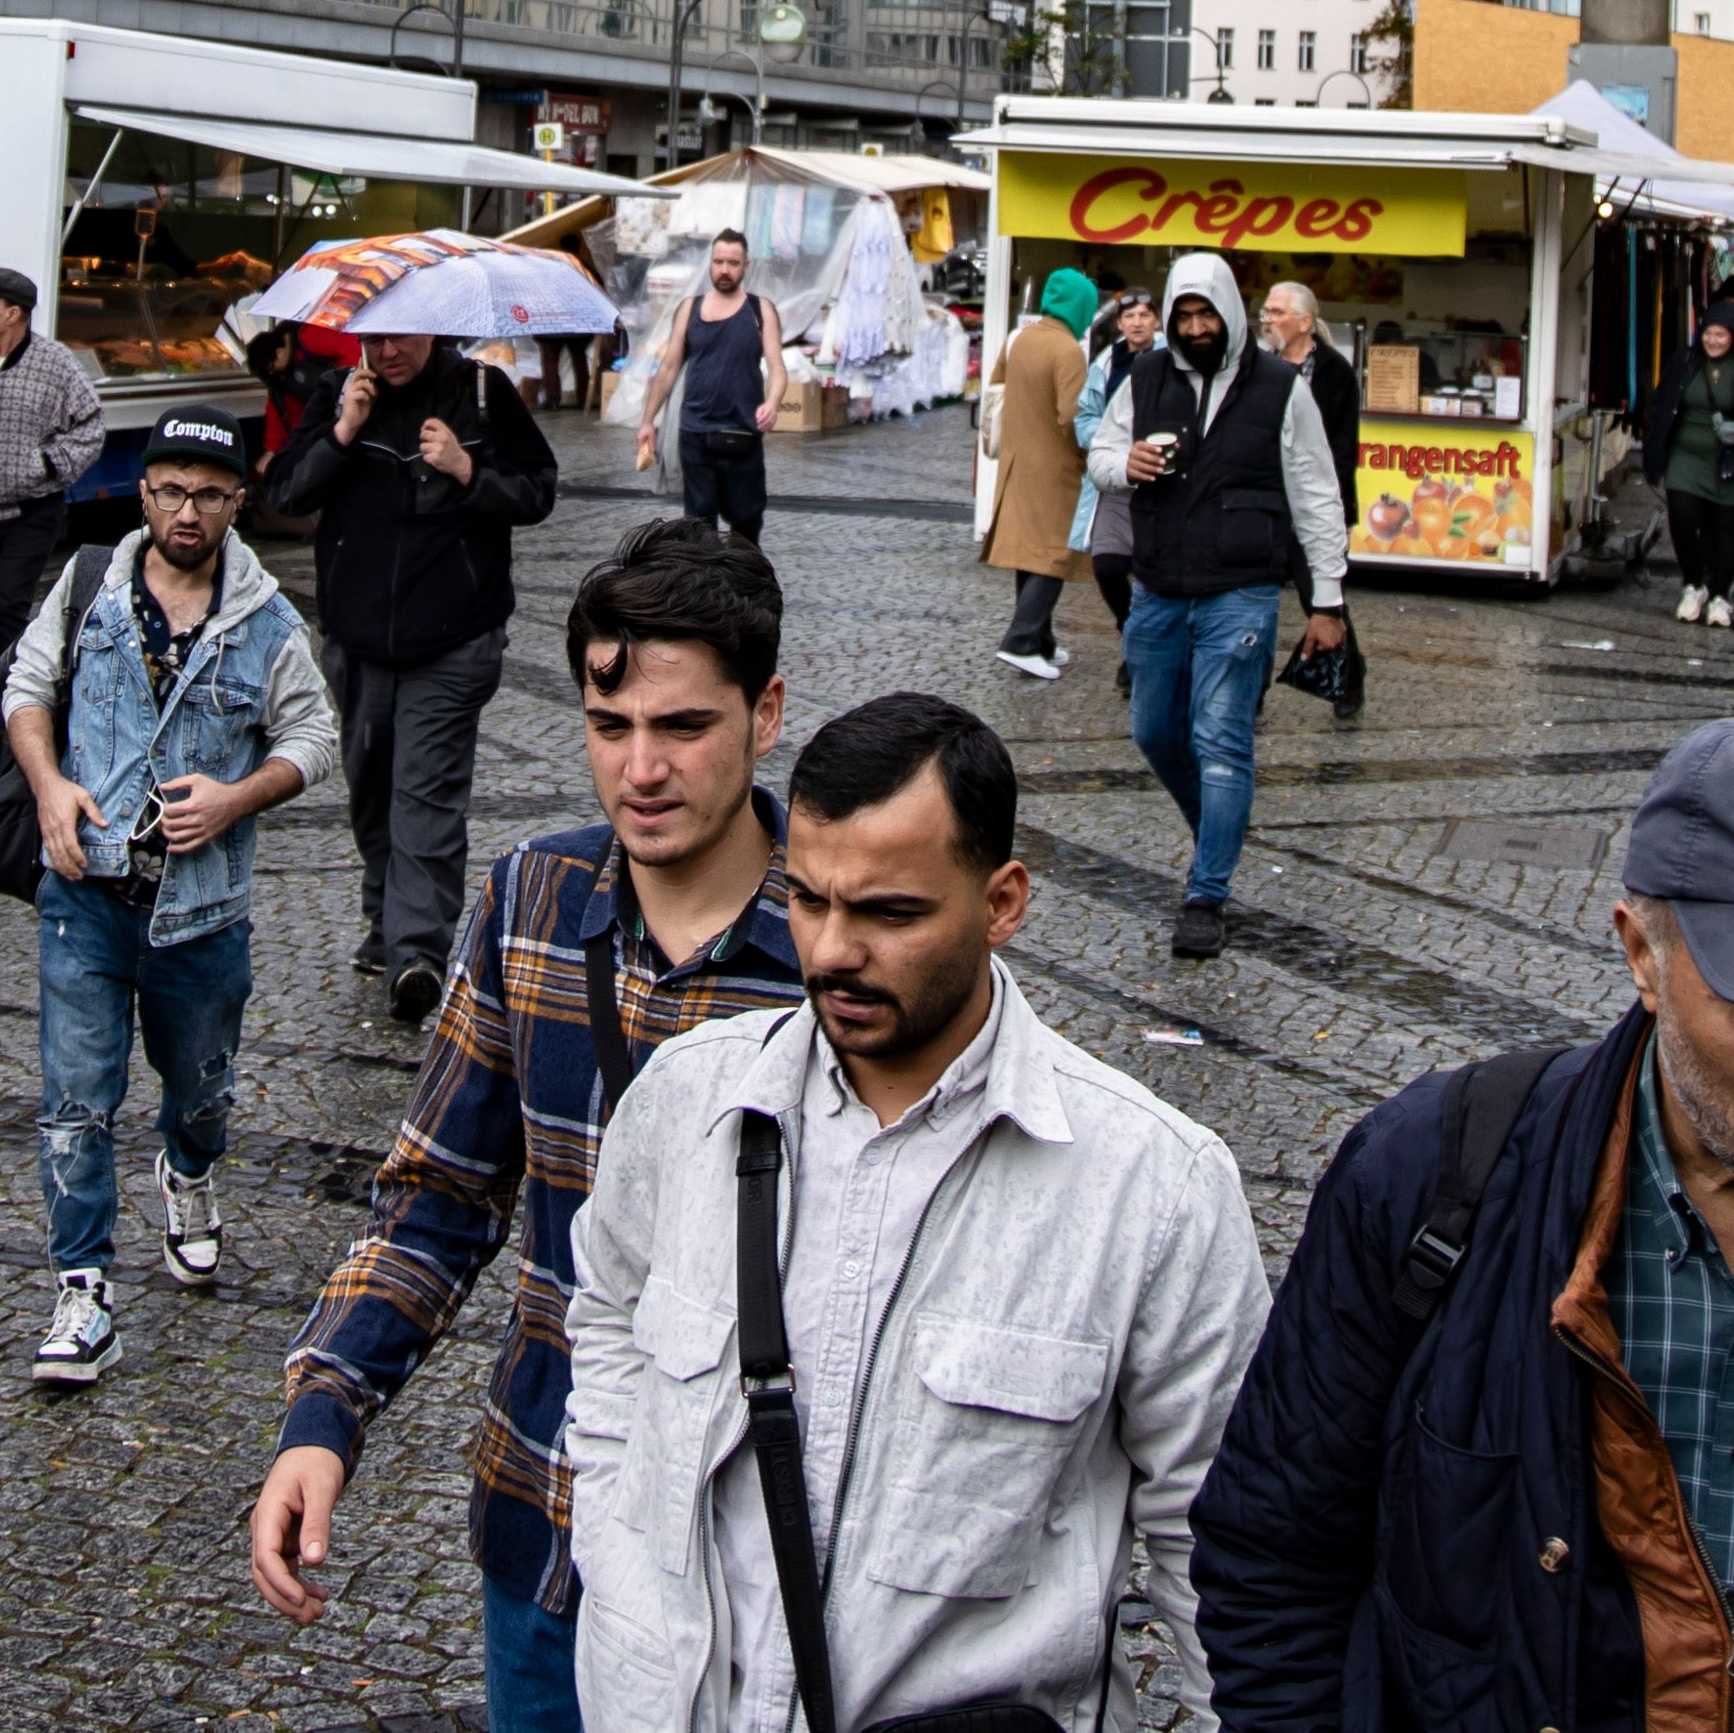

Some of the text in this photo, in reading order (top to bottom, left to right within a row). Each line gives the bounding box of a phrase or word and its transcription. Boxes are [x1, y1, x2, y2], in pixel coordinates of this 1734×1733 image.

[1070, 167, 1384, 249] Crêpes
[163, 419, 233, 446] Compton
[1358, 441, 1522, 480] rangensaft
